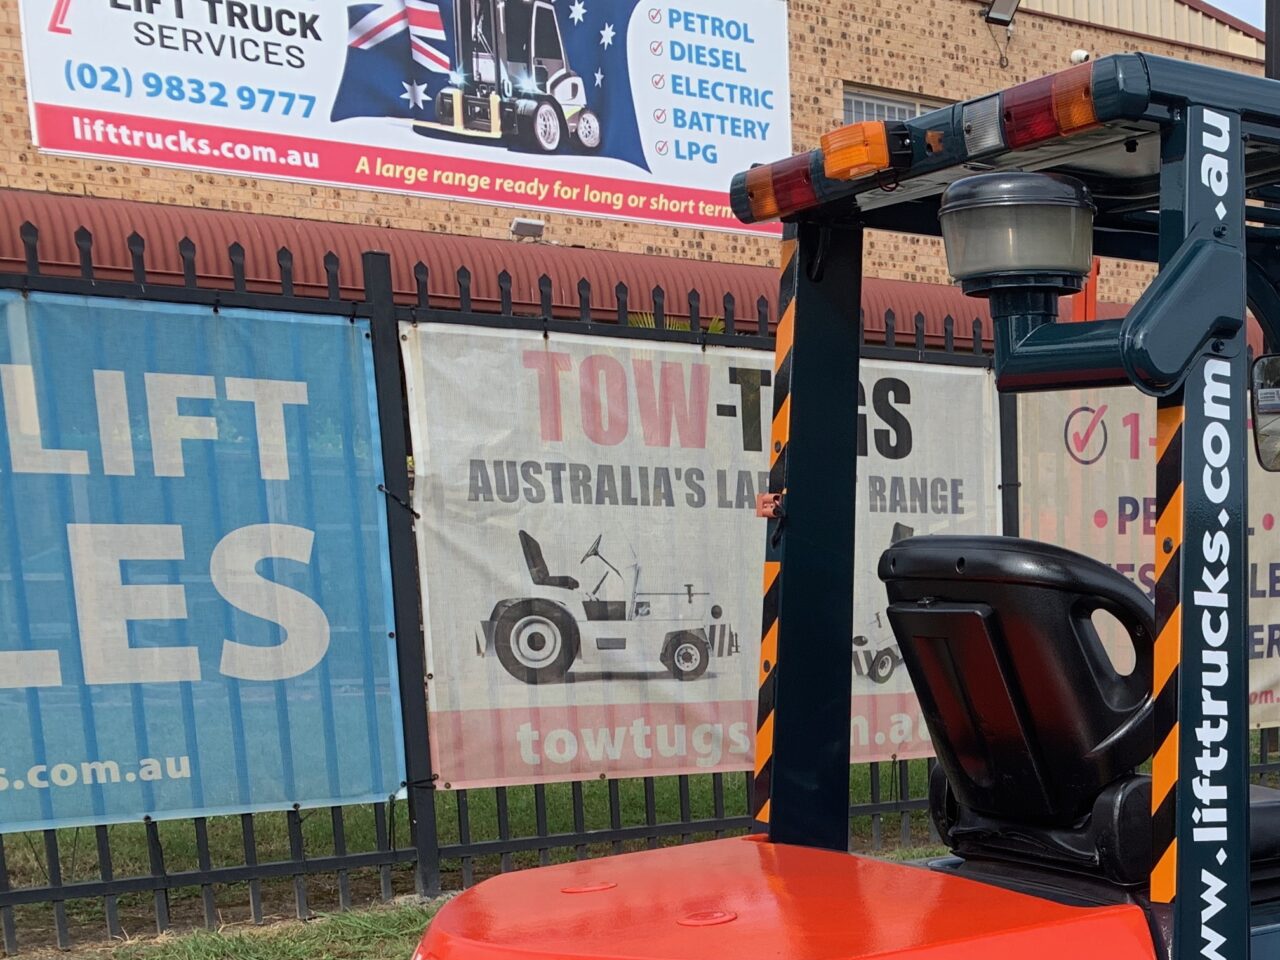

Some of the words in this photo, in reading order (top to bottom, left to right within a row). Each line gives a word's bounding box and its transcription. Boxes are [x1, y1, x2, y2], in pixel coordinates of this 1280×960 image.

[203, 0, 322, 41] TRUCK
[668, 9, 755, 43] PETROL
[133, 21, 305, 69] SERVICES
[670, 41, 746, 72] DIESEL
[65, 59, 132, 98] (02)
[142, 72, 229, 107] 9832
[236, 85, 316, 118] 9777
[671, 75, 774, 110] ELECTRIC
[72, 116, 319, 168] lifttrucks.com.au
[673, 108, 770, 141] BATTERY
[675, 140, 718, 164] LPG
[355, 156, 370, 174] A
[375, 157, 428, 185] large
[433, 169, 490, 192] range
[495, 177, 549, 200] ready
[553, 181, 580, 200] for
[584, 184, 624, 209] long
[628, 194, 647, 208] or
[650, 193, 695, 214] short
[468, 459, 706, 508] AUSTRALIA'S
[868, 475, 964, 515] RANGE
